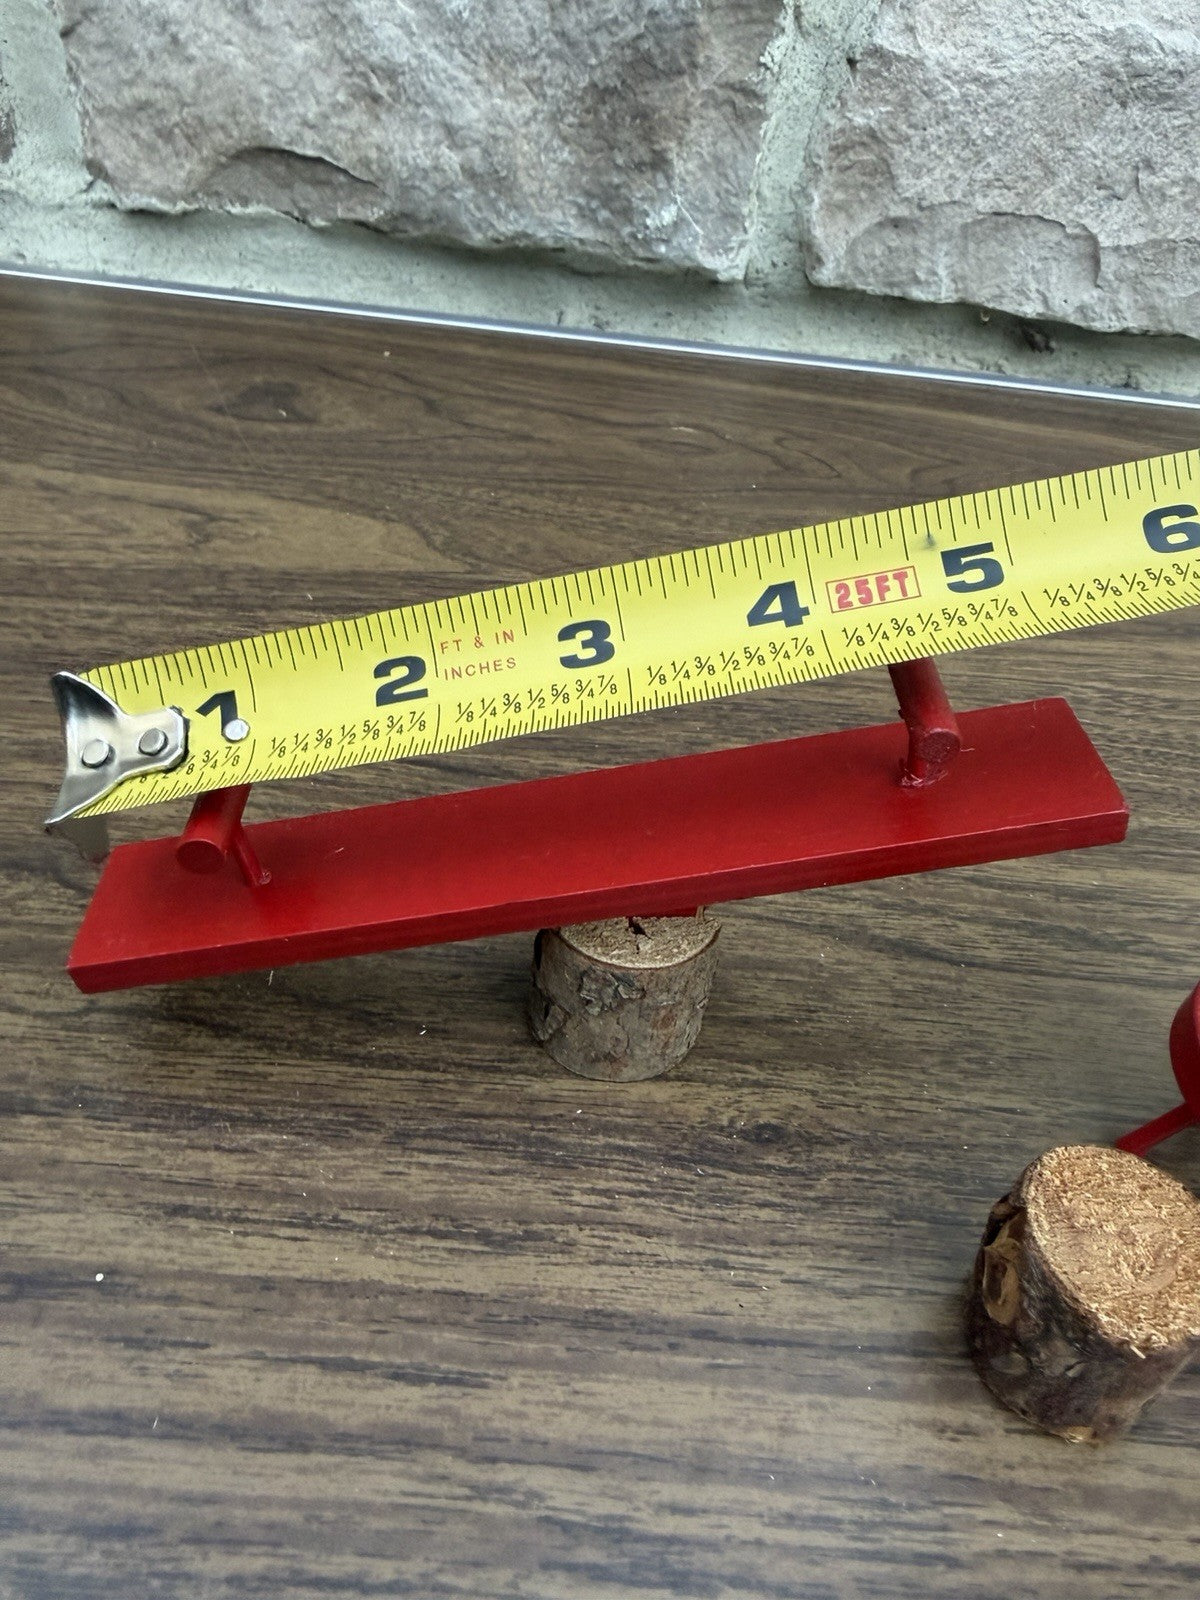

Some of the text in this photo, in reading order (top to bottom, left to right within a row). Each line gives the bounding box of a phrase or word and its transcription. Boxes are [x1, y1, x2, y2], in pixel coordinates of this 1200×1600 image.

[834, 571, 909, 610] 25FT
[195, 504, 1200, 736] 1 2 3 4 5 6
[440, 629, 515, 654] FT & IN
[444, 657, 517, 681] INCHES
